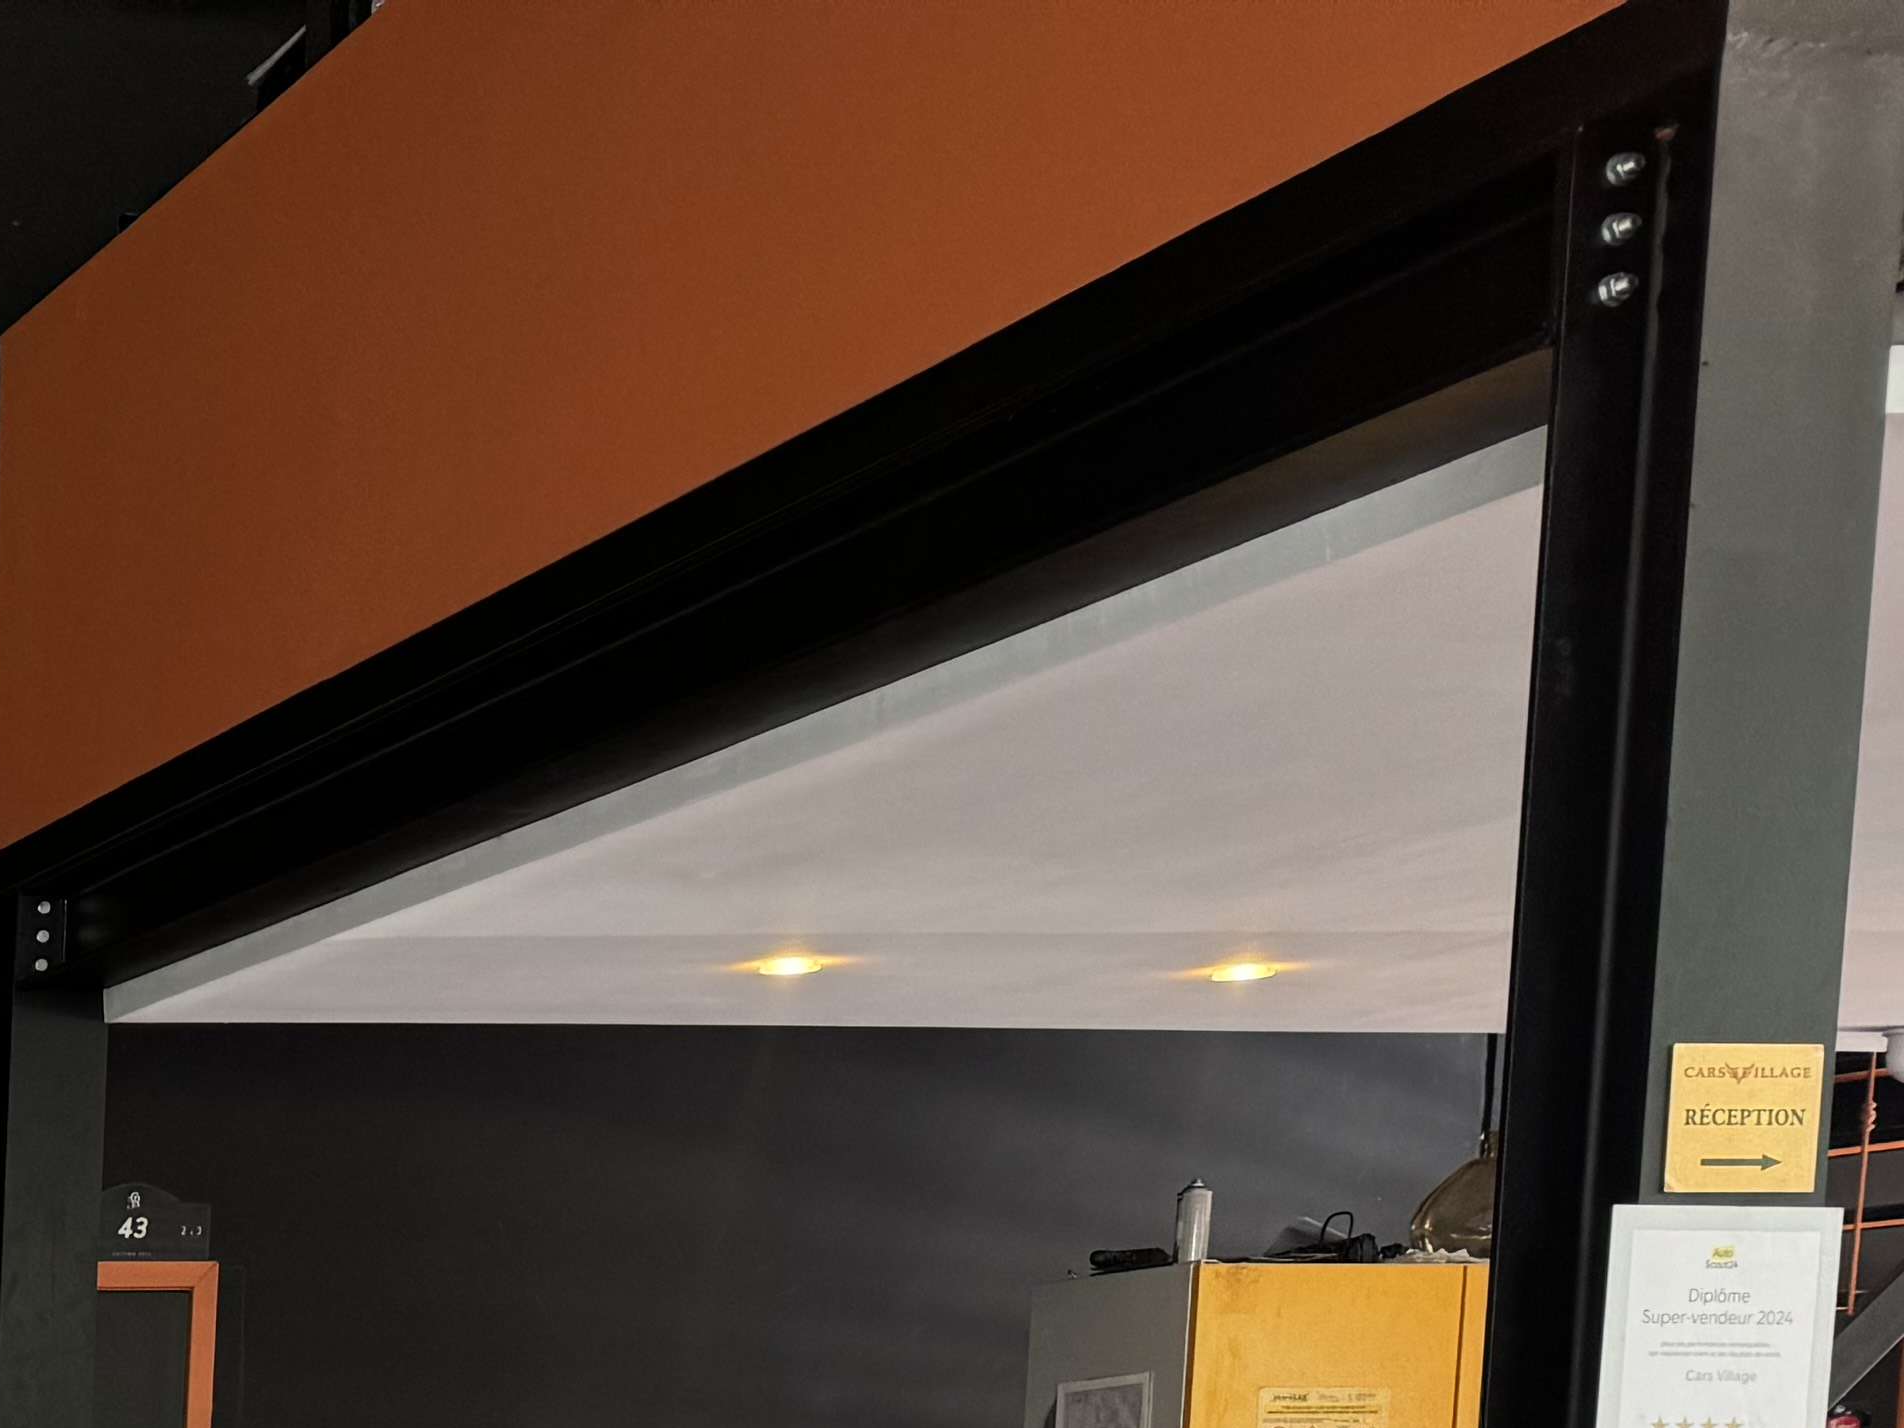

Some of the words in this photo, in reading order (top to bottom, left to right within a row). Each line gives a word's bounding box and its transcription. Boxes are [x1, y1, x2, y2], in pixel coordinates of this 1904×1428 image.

[1683, 1103, 1807, 1127] RÉCEPTION
[117, 1216, 149, 1239] 43
[1688, 1287, 1752, 1306] Diplôme
[1642, 1308, 1754, 1327] Super-vendeur
[1756, 1310, 1794, 1326] 2024
[1685, 1369, 1714, 1383] Cars
